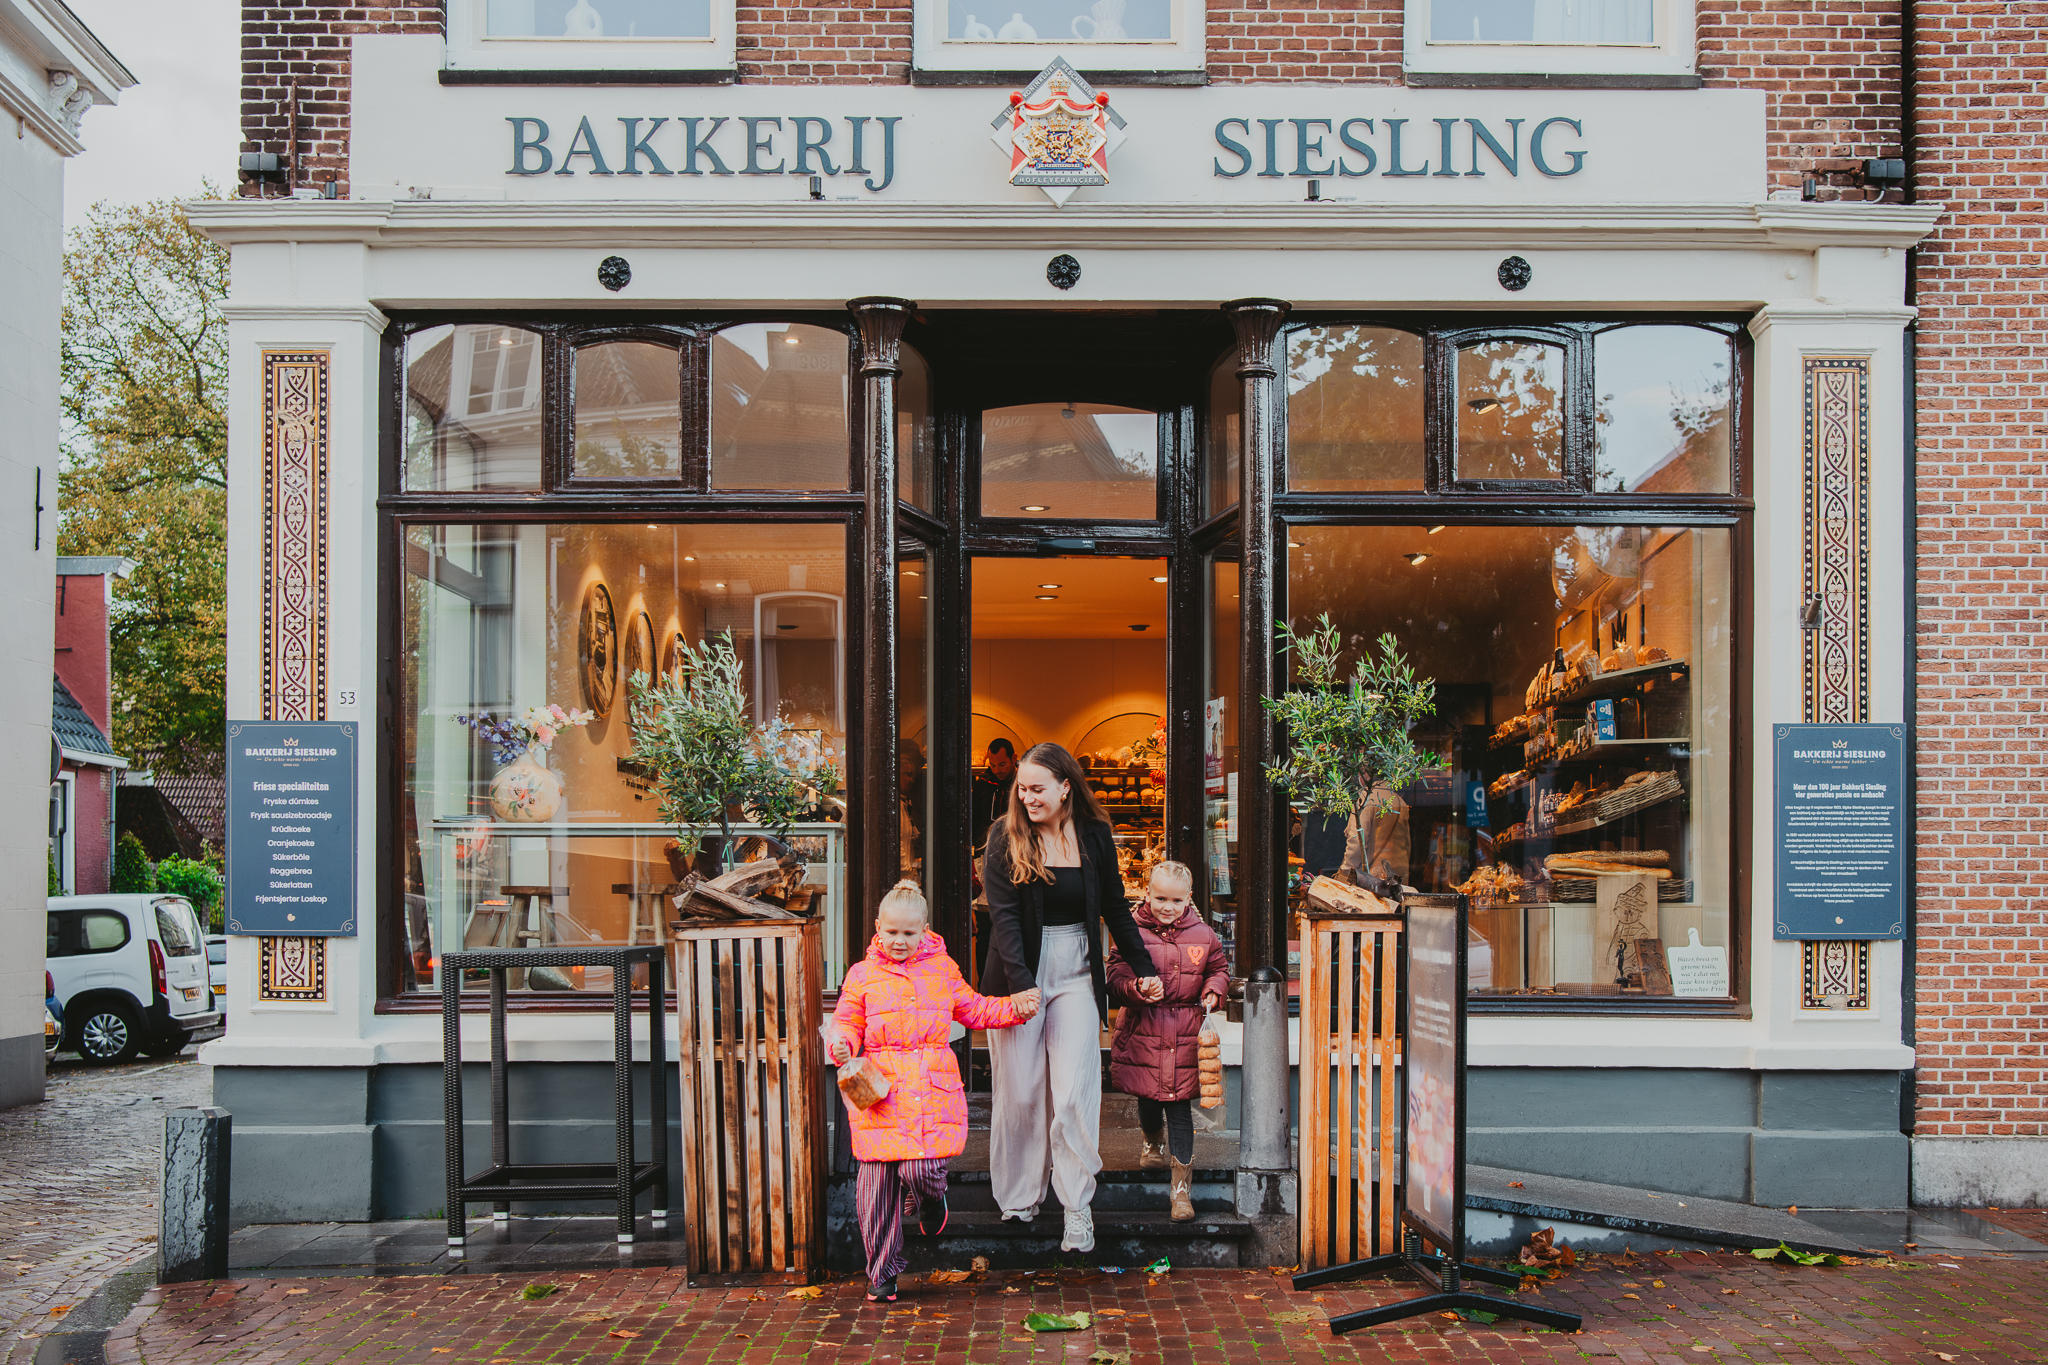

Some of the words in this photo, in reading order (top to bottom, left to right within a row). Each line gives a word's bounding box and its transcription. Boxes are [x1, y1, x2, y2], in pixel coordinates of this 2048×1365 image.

[1023, 63, 1057, 98] KONINKLIJKE
[1060, 63, 1096, 99] BESCHIKKING
[504, 115, 903, 192] BAKKERIJ
[1213, 116, 1589, 178] SIESLING
[1018, 176, 1099, 184] HOFLEVERANCIER
[340, 691, 356, 705] 53
[245, 748, 292, 756] BAKKERIJ
[294, 748, 337, 756] SIESLING
[1793, 750, 1841, 758] BAKKERIJ
[1843, 750, 1886, 758] SIESLING
[253, 782, 276, 791] Friese
[278, 782, 329, 792] specialiteiten
[1793, 783, 1806, 791] Meer
[1808, 783, 1818, 791] dan
[1819, 783, 1829, 791] 100
[1842, 783, 1864, 791] Bakkerij
[1866, 783, 1887, 791] Siesling
[263, 798, 287, 806] Fryske
[288, 797, 319, 805] dúmkes
[250, 812, 270, 820] Frysk
[271, 811, 332, 821] sausizebroadsje
[271, 825, 311, 833] Krûdkoeke
[267, 839, 315, 848] Oranjekoeke
[270, 867, 313, 876] Roggebrea
[255, 895, 300, 904] Frjentsjerter
[301, 895, 328, 904] Loskop
